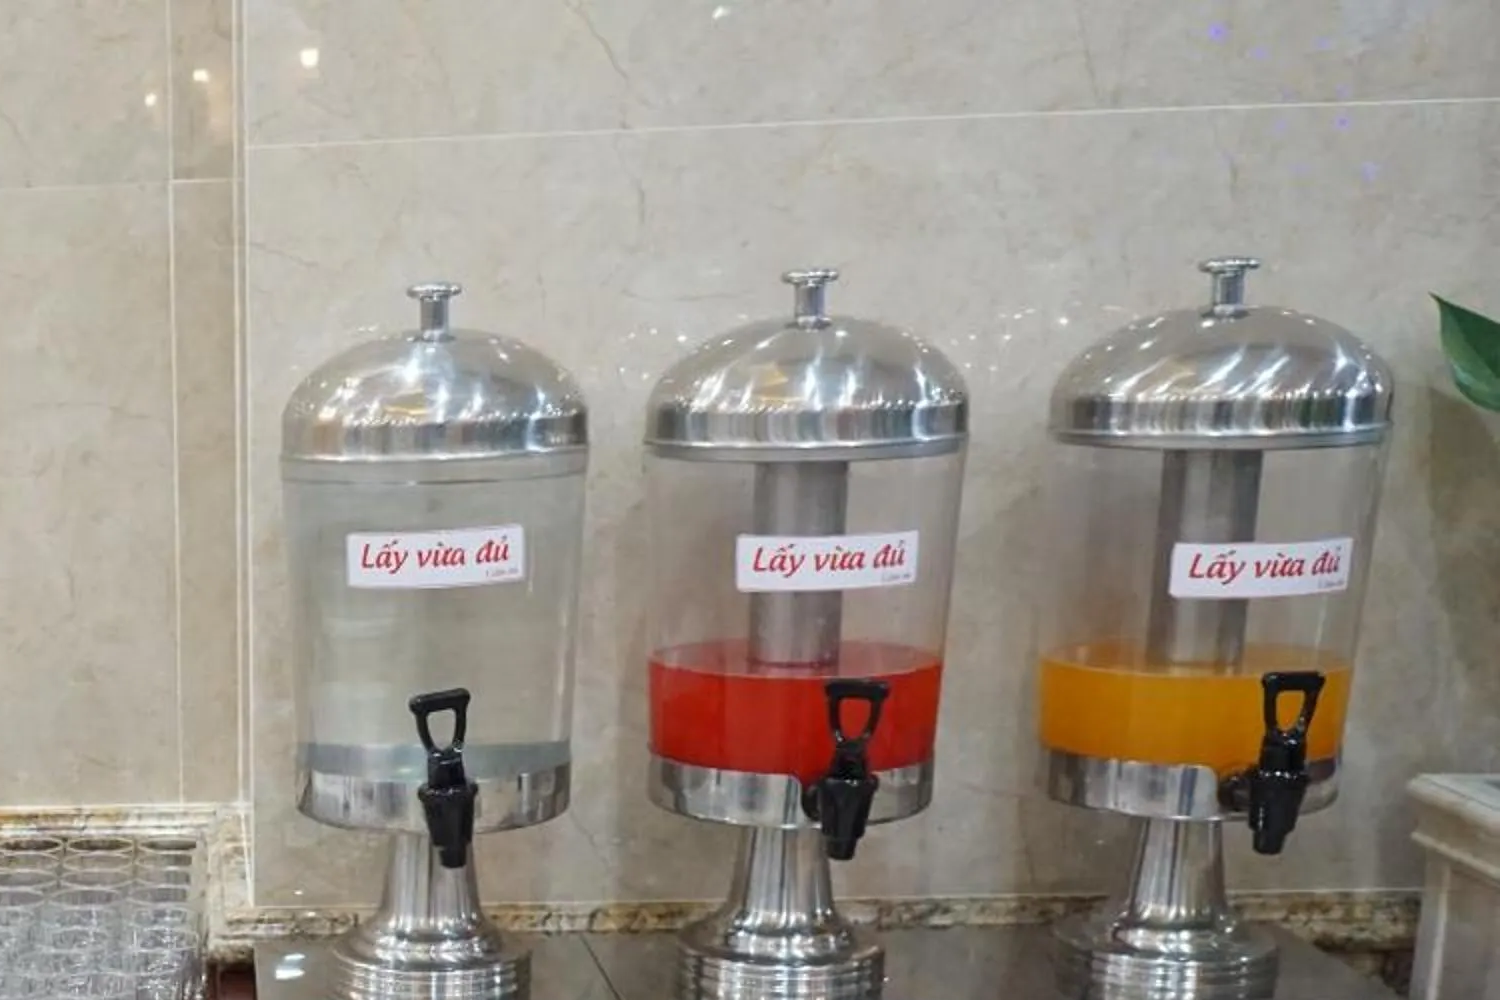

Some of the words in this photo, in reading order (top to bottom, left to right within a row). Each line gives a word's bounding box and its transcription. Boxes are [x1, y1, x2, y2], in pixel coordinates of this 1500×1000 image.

[361, 540, 408, 574] Lấy
[417, 541, 466, 568] vừa
[476, 535, 510, 565] đủ
[753, 543, 805, 578] Lấy
[814, 546, 865, 572] vừa
[873, 539, 906, 568] đủ
[1189, 550, 1247, 585] Lấy
[1254, 553, 1307, 578] vừa
[1311, 545, 1342, 576] đủ
